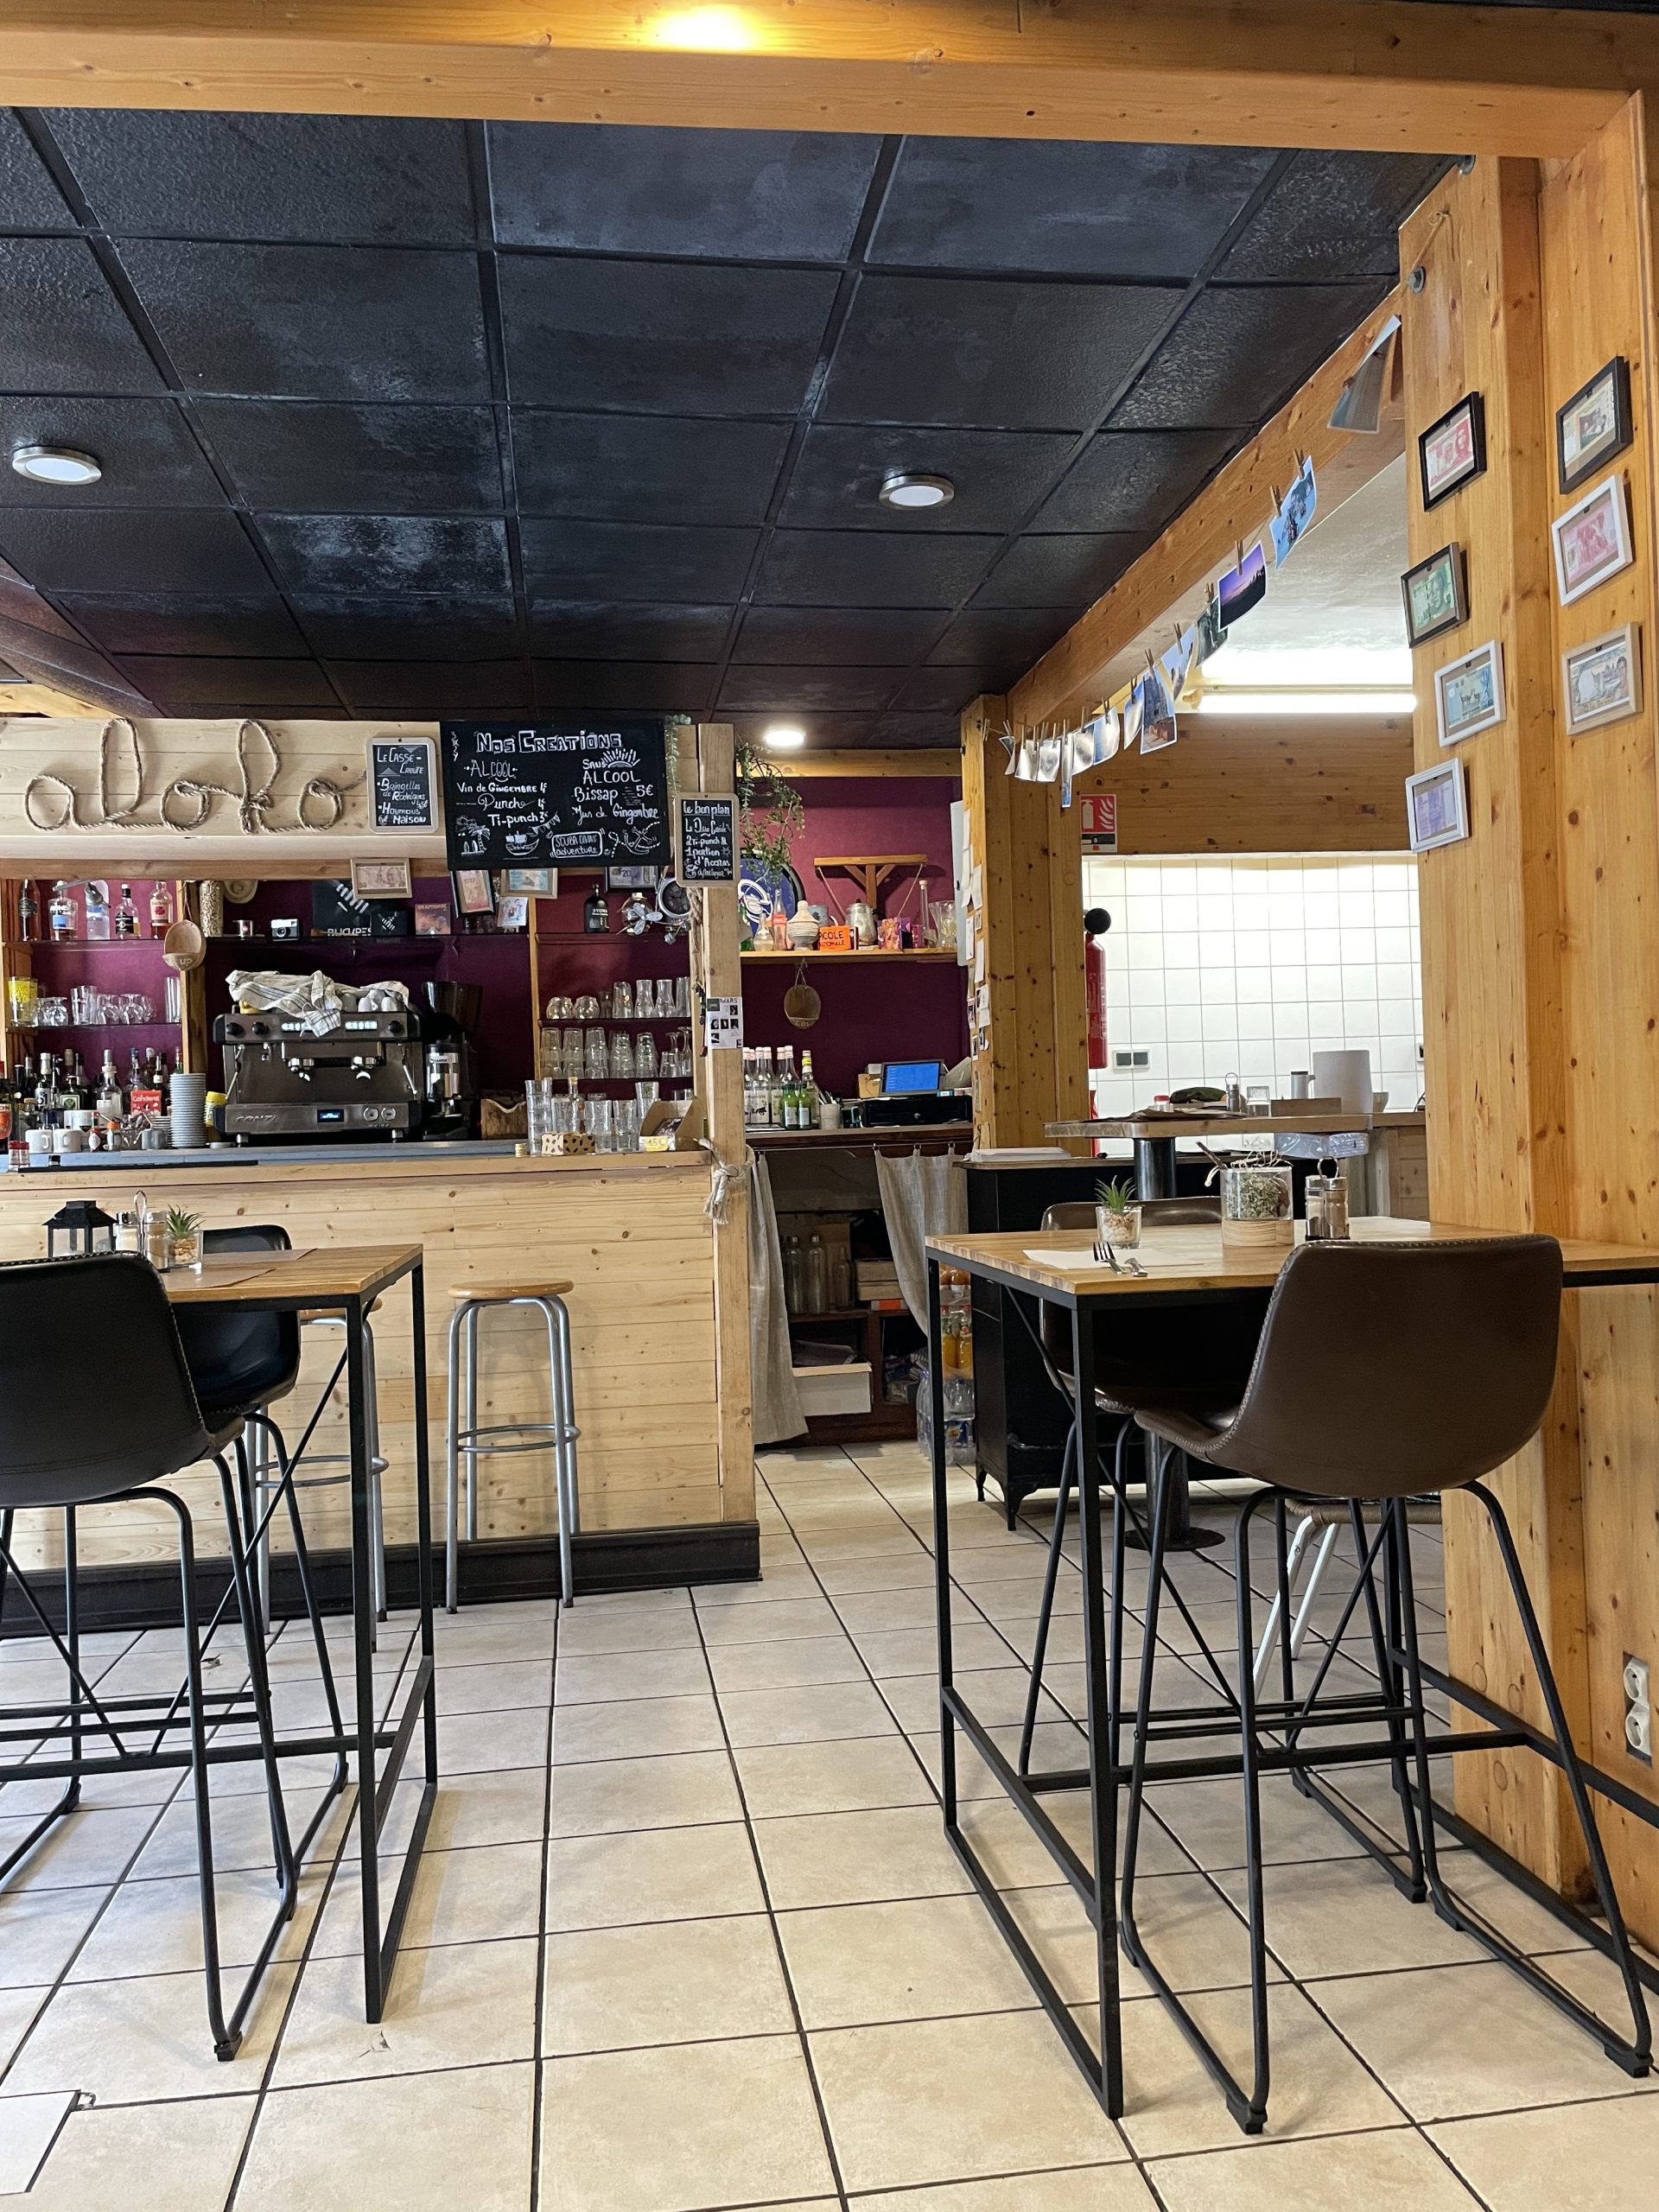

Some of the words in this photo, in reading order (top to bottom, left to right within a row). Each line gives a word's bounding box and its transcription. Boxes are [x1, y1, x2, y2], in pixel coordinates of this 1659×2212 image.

[470, 760, 516, 778] ALCOOL
[582, 771, 641, 785] ALCOOL
[456, 782, 473, 792] Vin
[476, 783, 486, 792] de
[574, 786, 618, 805] Bissap
[636, 785, 653, 797] 5€
[487, 811, 538, 828] Ti-punch
[710, 804, 730, 819] plan
